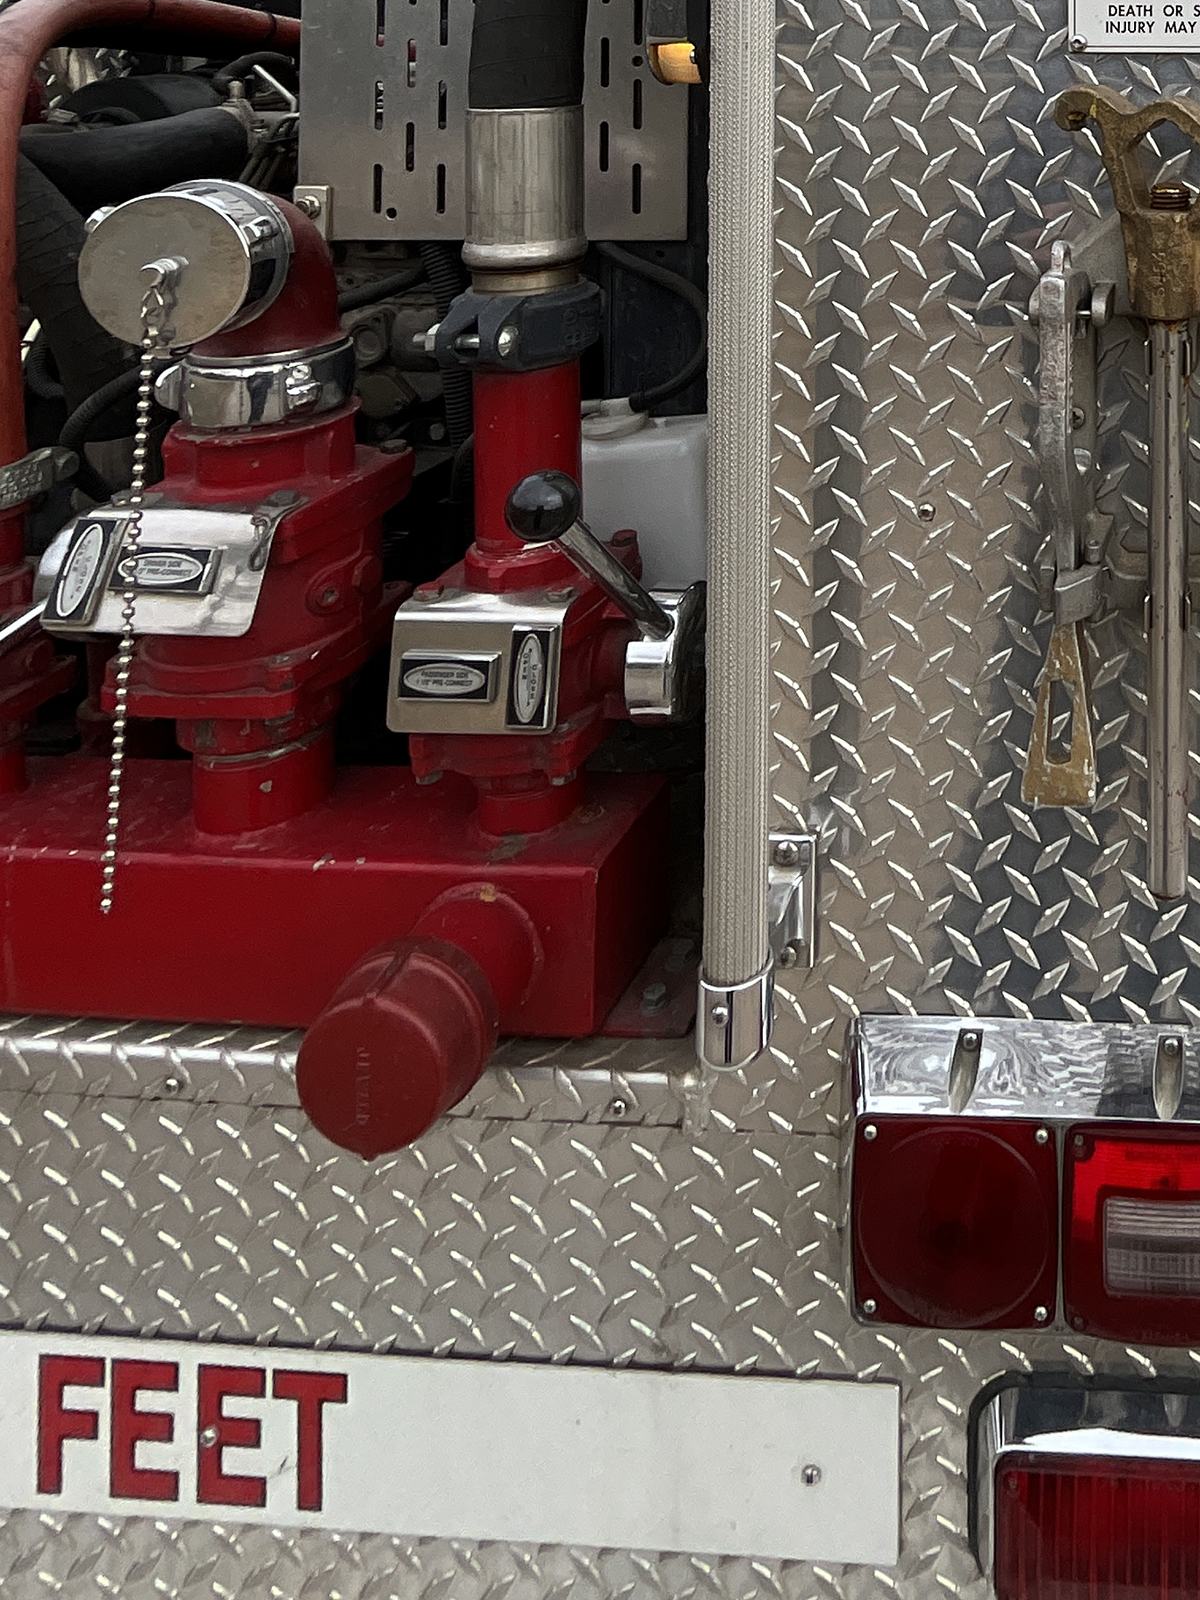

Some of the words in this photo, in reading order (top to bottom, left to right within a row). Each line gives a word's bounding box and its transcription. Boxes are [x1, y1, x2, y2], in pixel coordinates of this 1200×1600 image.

[1108, 5, 1153, 17] DEATH
[1163, 5, 1183, 17] OR
[1105, 22, 1155, 33] INJURY
[1165, 22, 1197, 33] MAY
[36, 1353, 349, 1512] FEET
